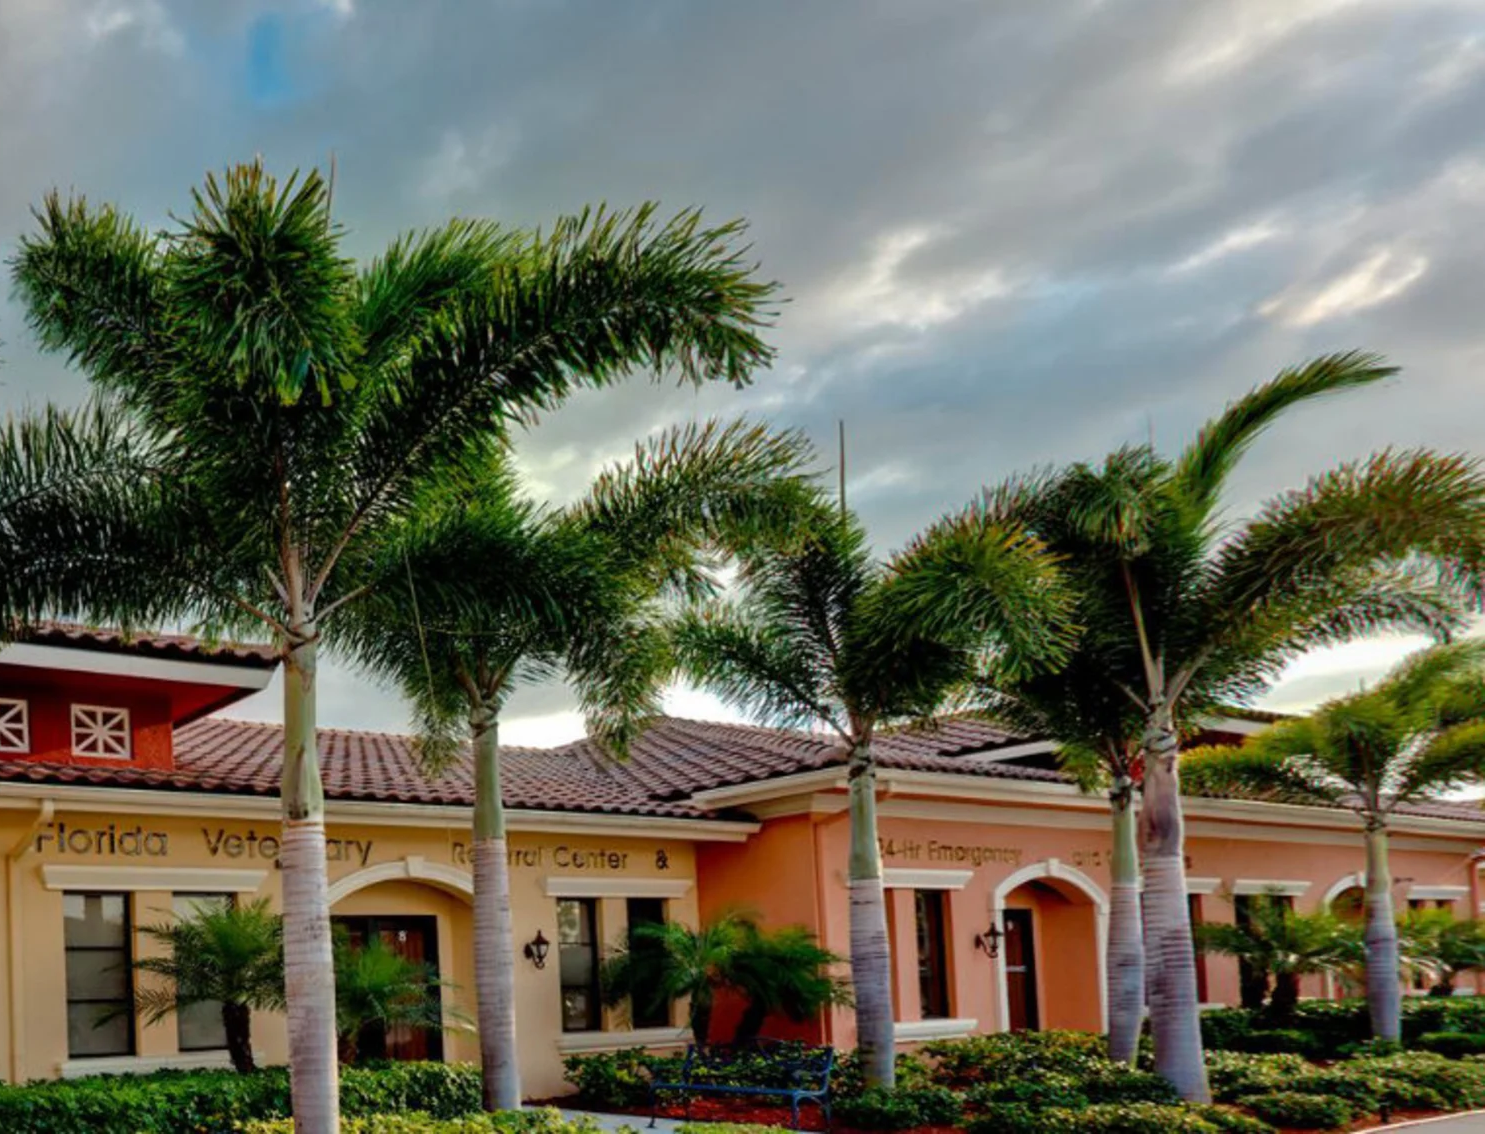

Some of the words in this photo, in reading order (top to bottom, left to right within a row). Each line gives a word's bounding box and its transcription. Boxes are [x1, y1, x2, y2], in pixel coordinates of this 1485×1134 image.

[35, 821, 167, 856] Florida
[201, 828, 373, 867] Veteary
[451, 841, 543, 867] Rerral
[552, 845, 628, 869] Center
[655, 849, 669, 870] &
[926, 840, 1024, 867] Emergency
